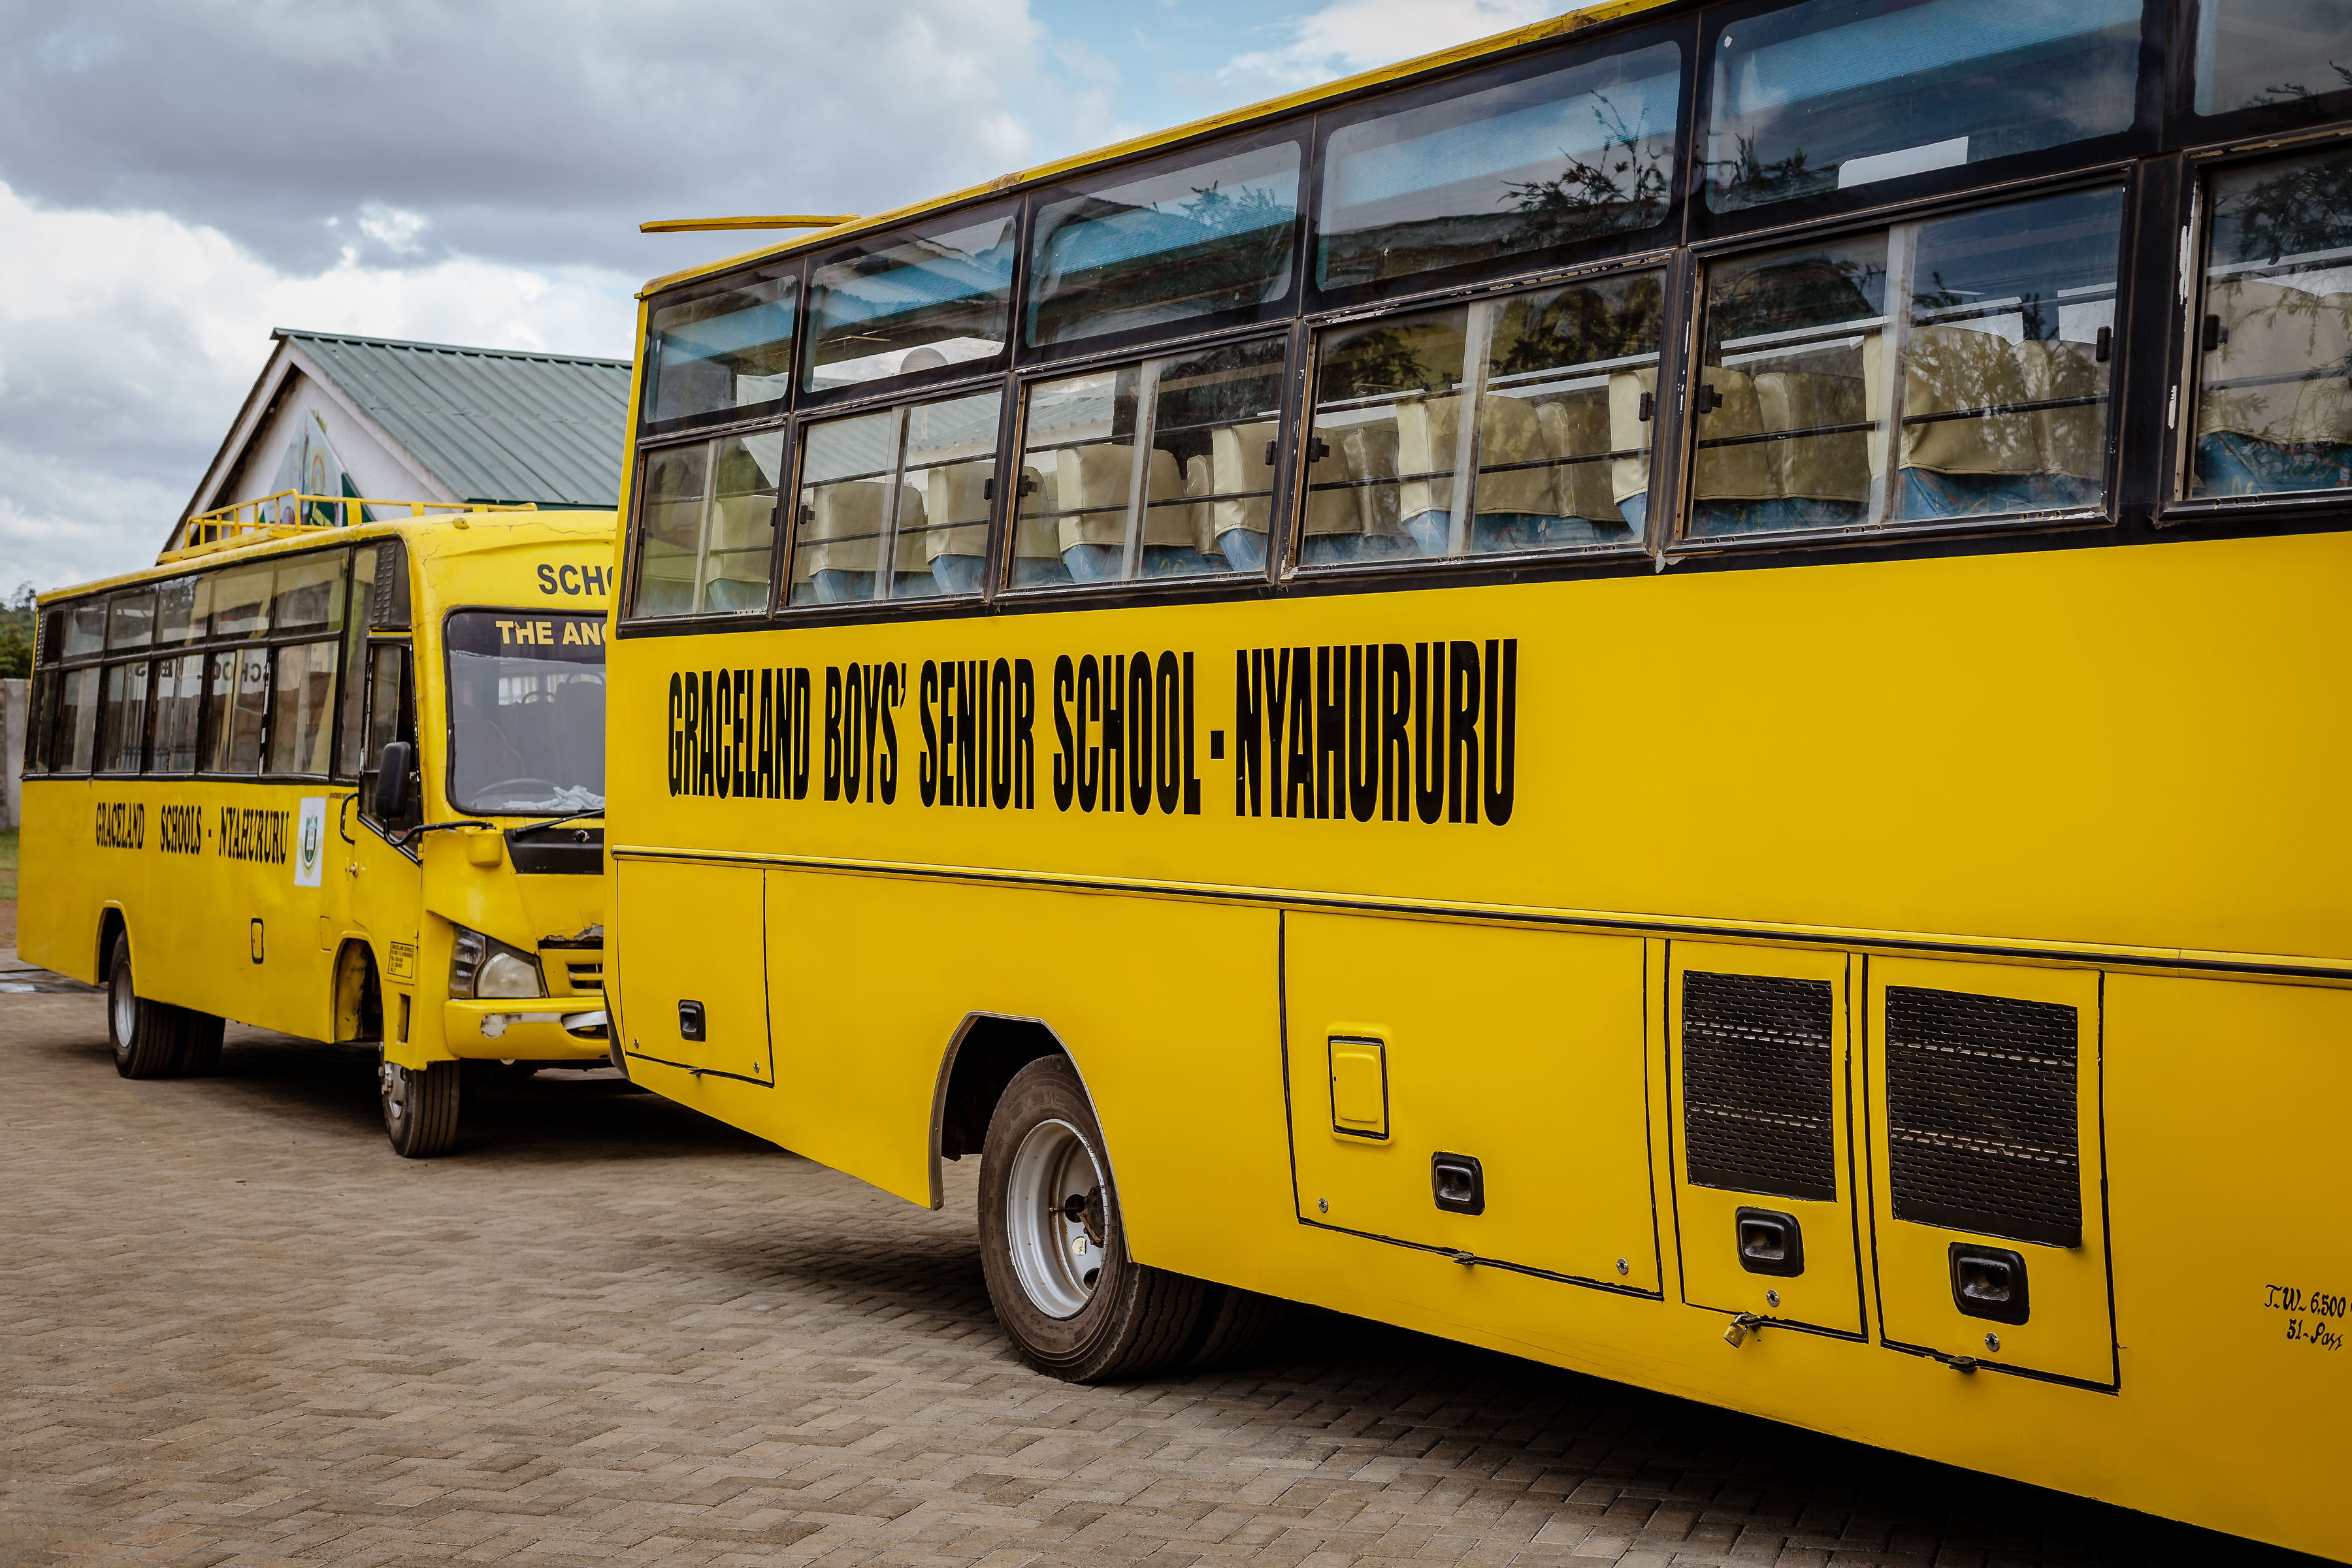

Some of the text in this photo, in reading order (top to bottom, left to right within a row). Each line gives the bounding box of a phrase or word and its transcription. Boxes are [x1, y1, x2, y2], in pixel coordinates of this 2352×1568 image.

[538, 564, 613, 596] SCH
[495, 620, 607, 645] THE AN
[668, 668, 811, 800] GRACELAND
[823, 662, 907, 805] BOYS'
[919, 657, 1035, 810] SENIOR
[1053, 651, 1201, 815] SCHOOL
[1235, 638, 1518, 826] NYAHURURU
[95, 802, 145, 849] GRACELAND
[160, 804, 202, 855] SCHOOLS
[218, 806, 289, 865] NYAHURURU
